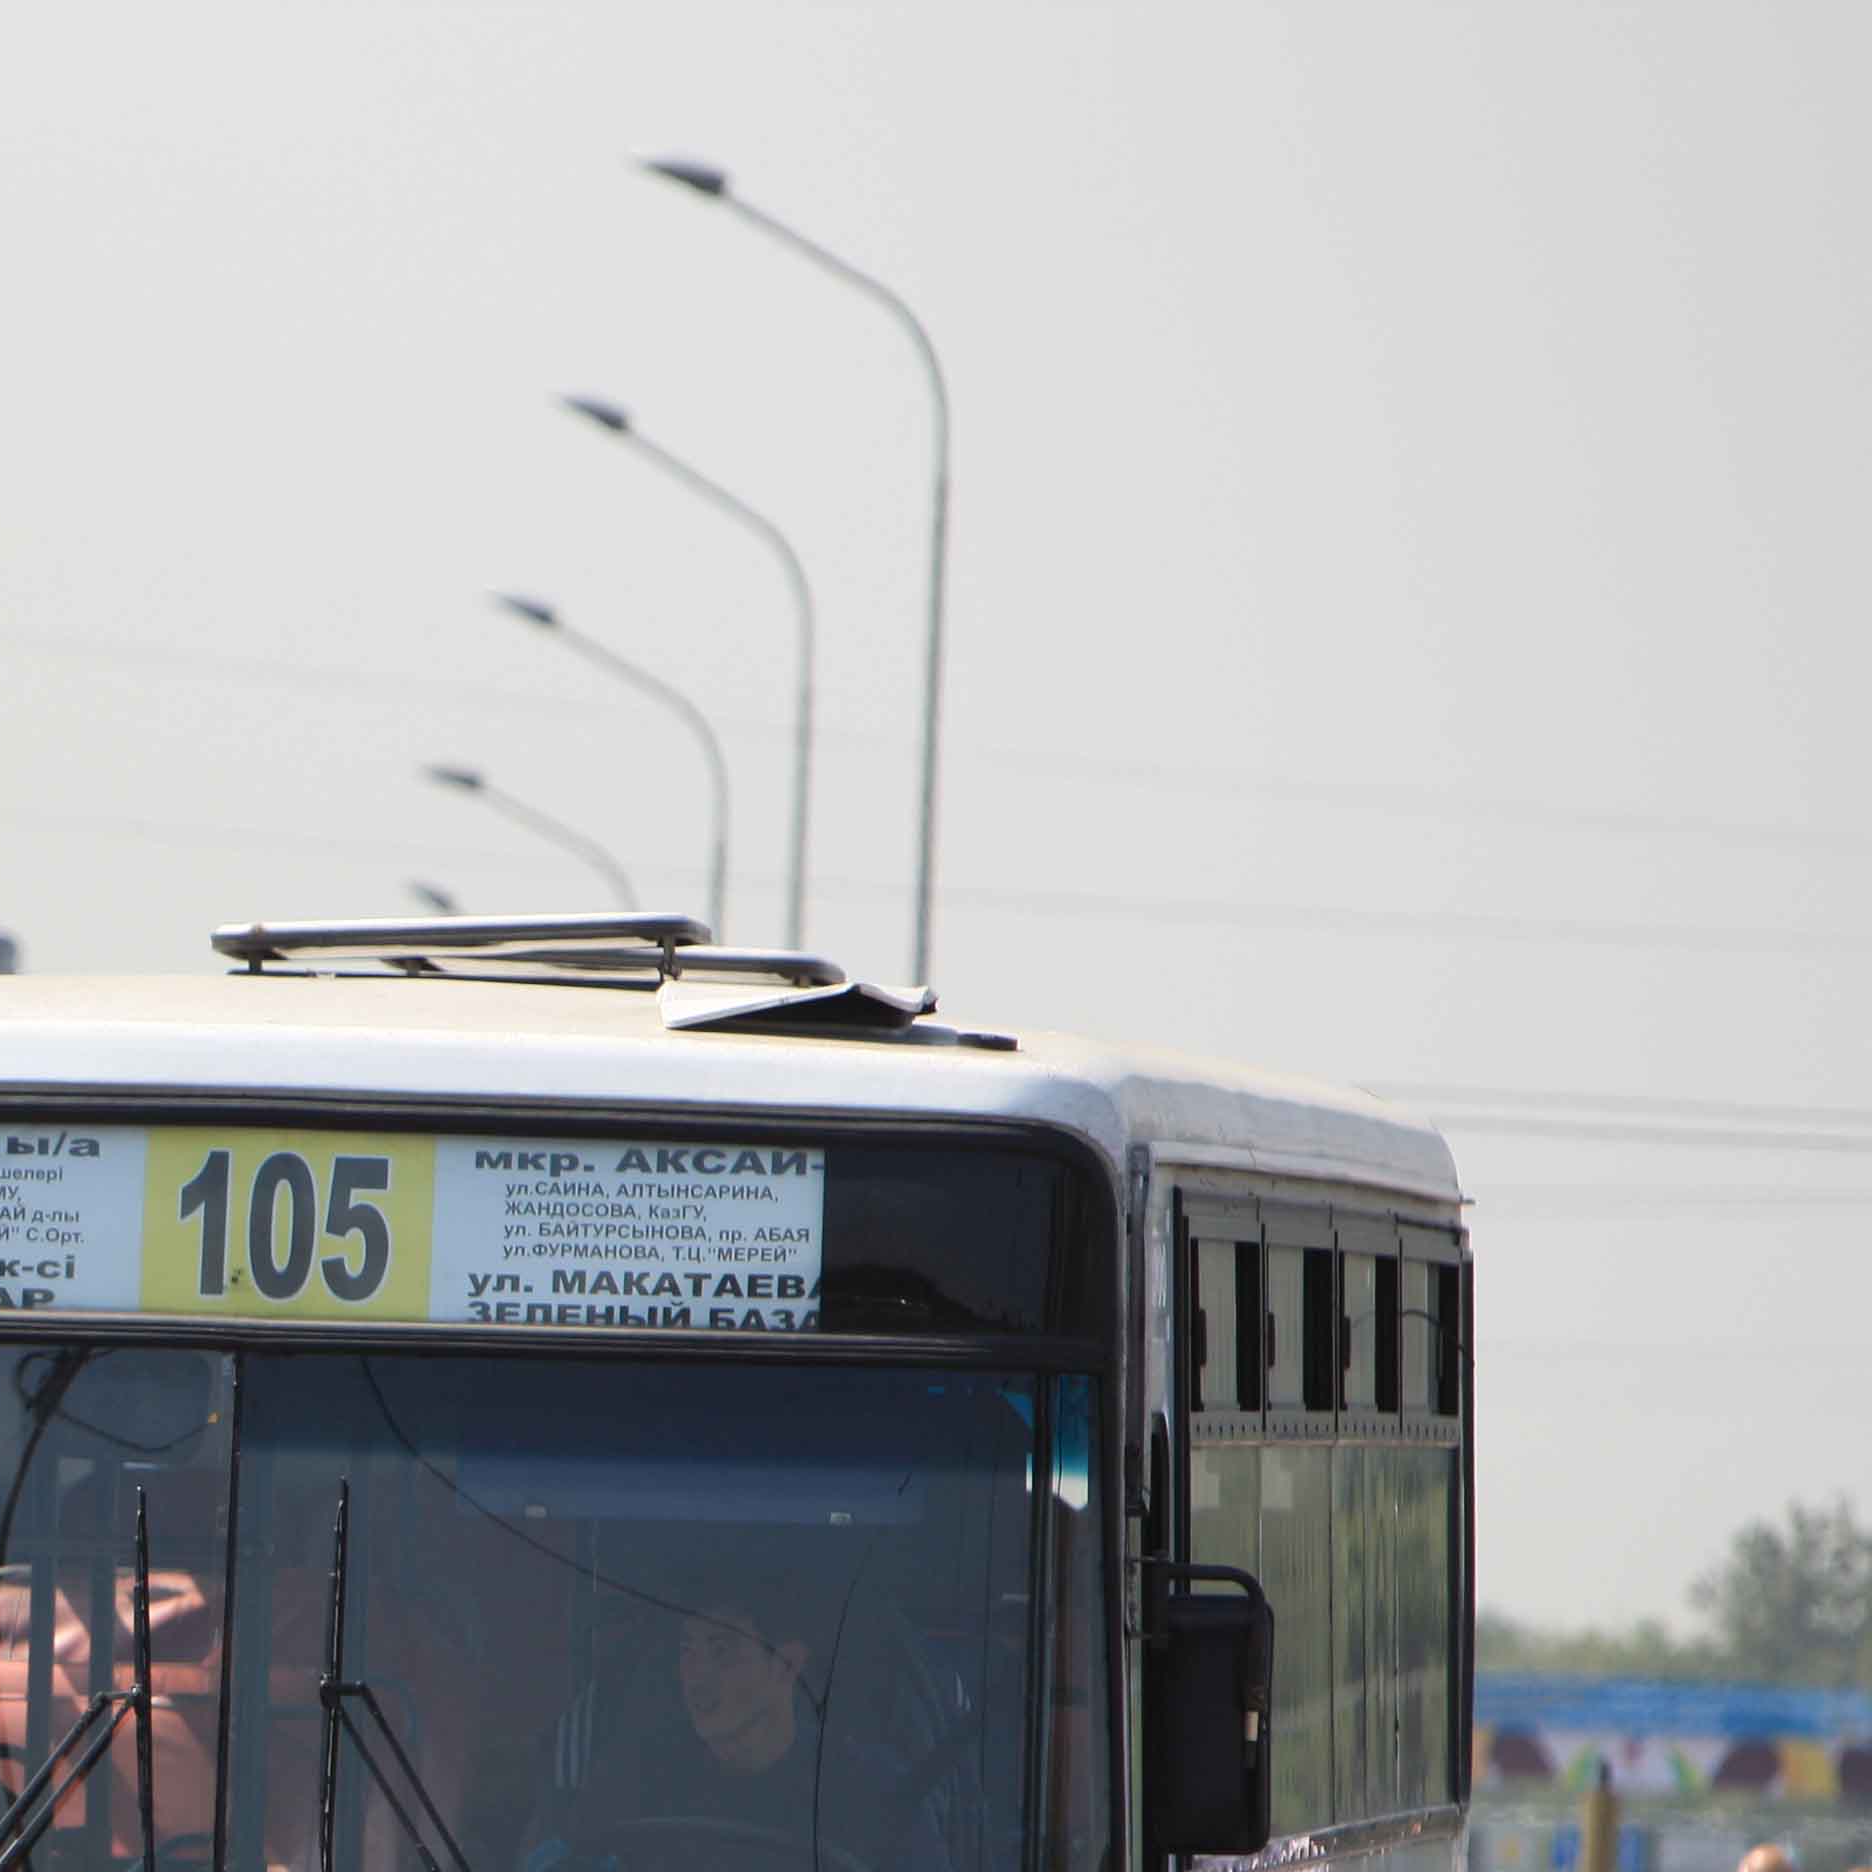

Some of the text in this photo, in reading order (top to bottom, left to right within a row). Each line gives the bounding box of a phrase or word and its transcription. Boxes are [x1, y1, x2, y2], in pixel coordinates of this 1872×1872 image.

[6, 1131, 100, 1157] ы/а
[475, 1150, 595, 1177] мкр.
[616, 1183, 778, 1202] АЛТЫНСАРИНА,
[31, 1212, 80, 1224] д-лы
[505, 1202, 707, 1222] ЖАНДОСОВА, КазГУ,
[178, 1149, 391, 1302] 105
[504, 1221, 809, 1244] ул. БАЙТУРСЫНОВА, пр. АБАЯ
[467, 1272, 533, 1297] ул.
